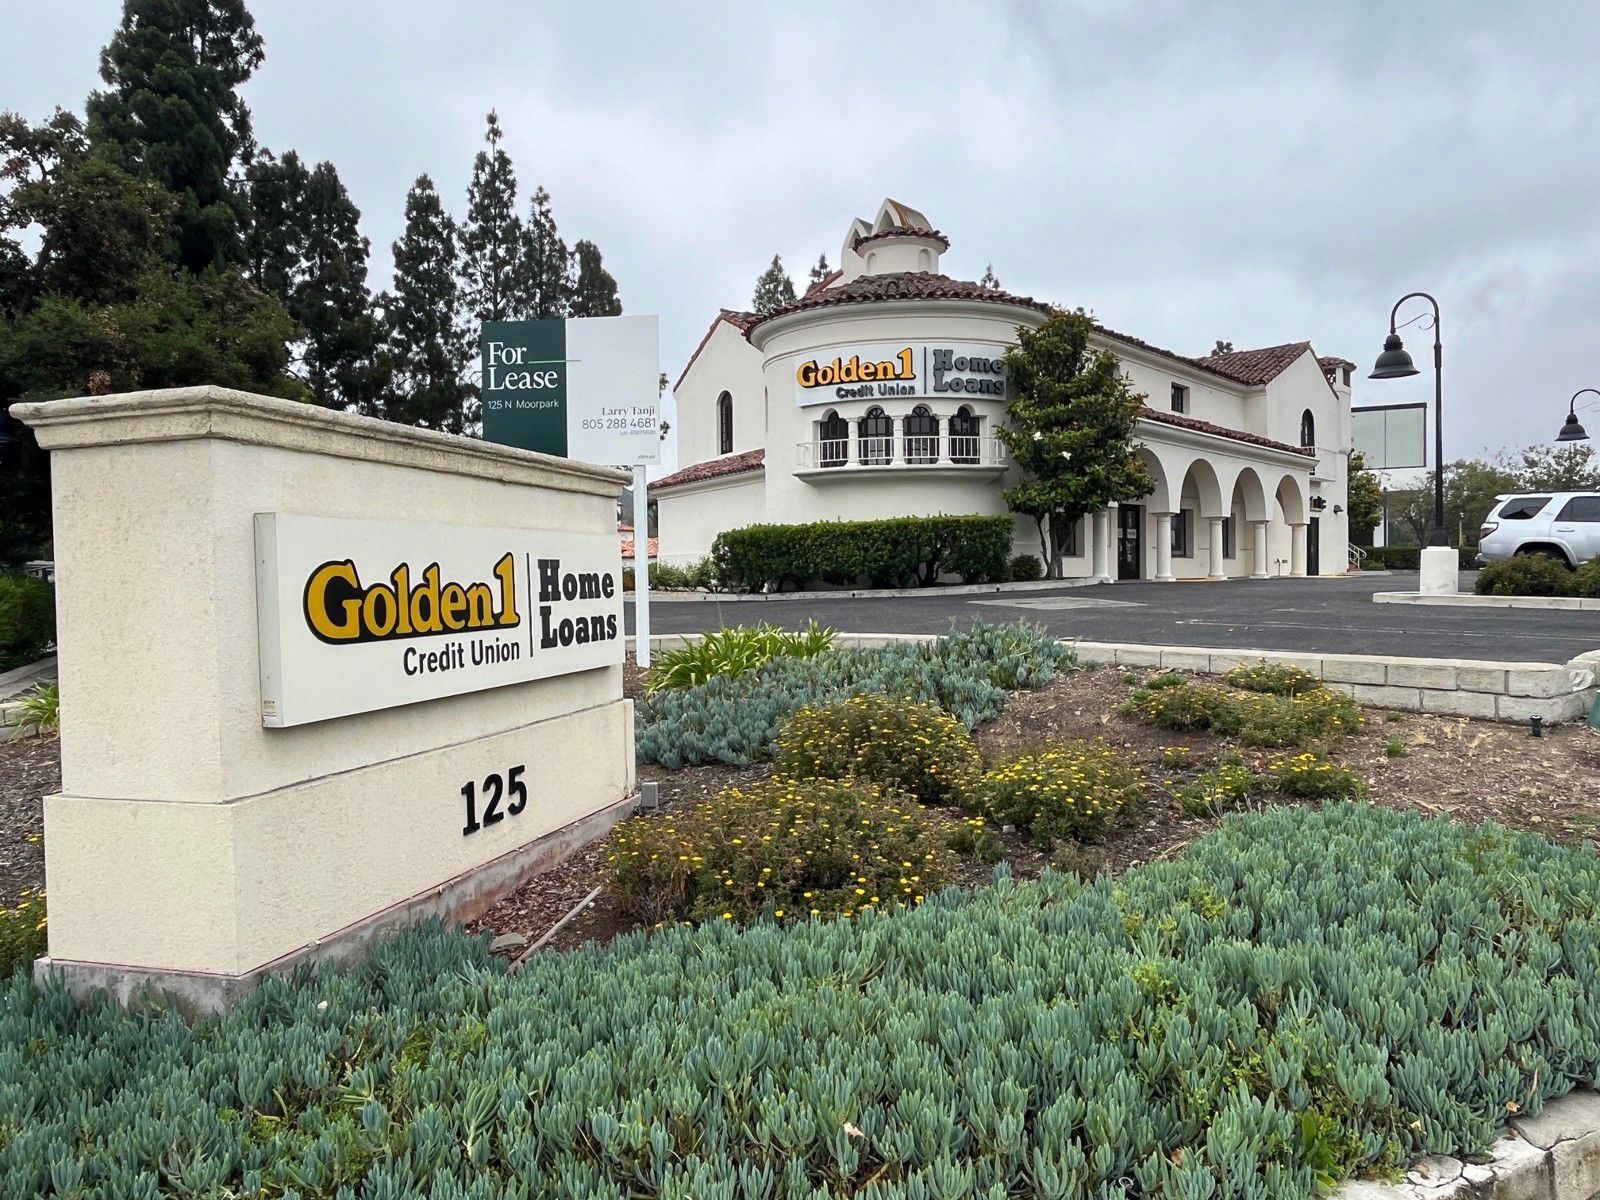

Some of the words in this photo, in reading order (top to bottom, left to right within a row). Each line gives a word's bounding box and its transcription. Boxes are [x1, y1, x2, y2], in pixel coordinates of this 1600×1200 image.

[487, 341, 528, 366] For
[933, 349, 1003, 374] Home
[488, 367, 558, 391] Lease
[835, 384, 874, 399] Credit
[877, 382, 916, 397] Union
[933, 369, 1005, 395] Loans
[488, 400, 502, 410] 125
[505, 401, 512, 409] N
[516, 399, 559, 410] Moorpark
[602, 407, 627, 417] Larry
[582, 419, 604, 430] 805
[606, 418, 627, 429] 288
[630, 417, 656, 428] 4681
[537, 559, 615, 602] Home
[540, 606, 618, 649] Loans
[403, 643, 465, 676] Credit
[471, 638, 520, 667] Union
[460, 765, 528, 837] 125
